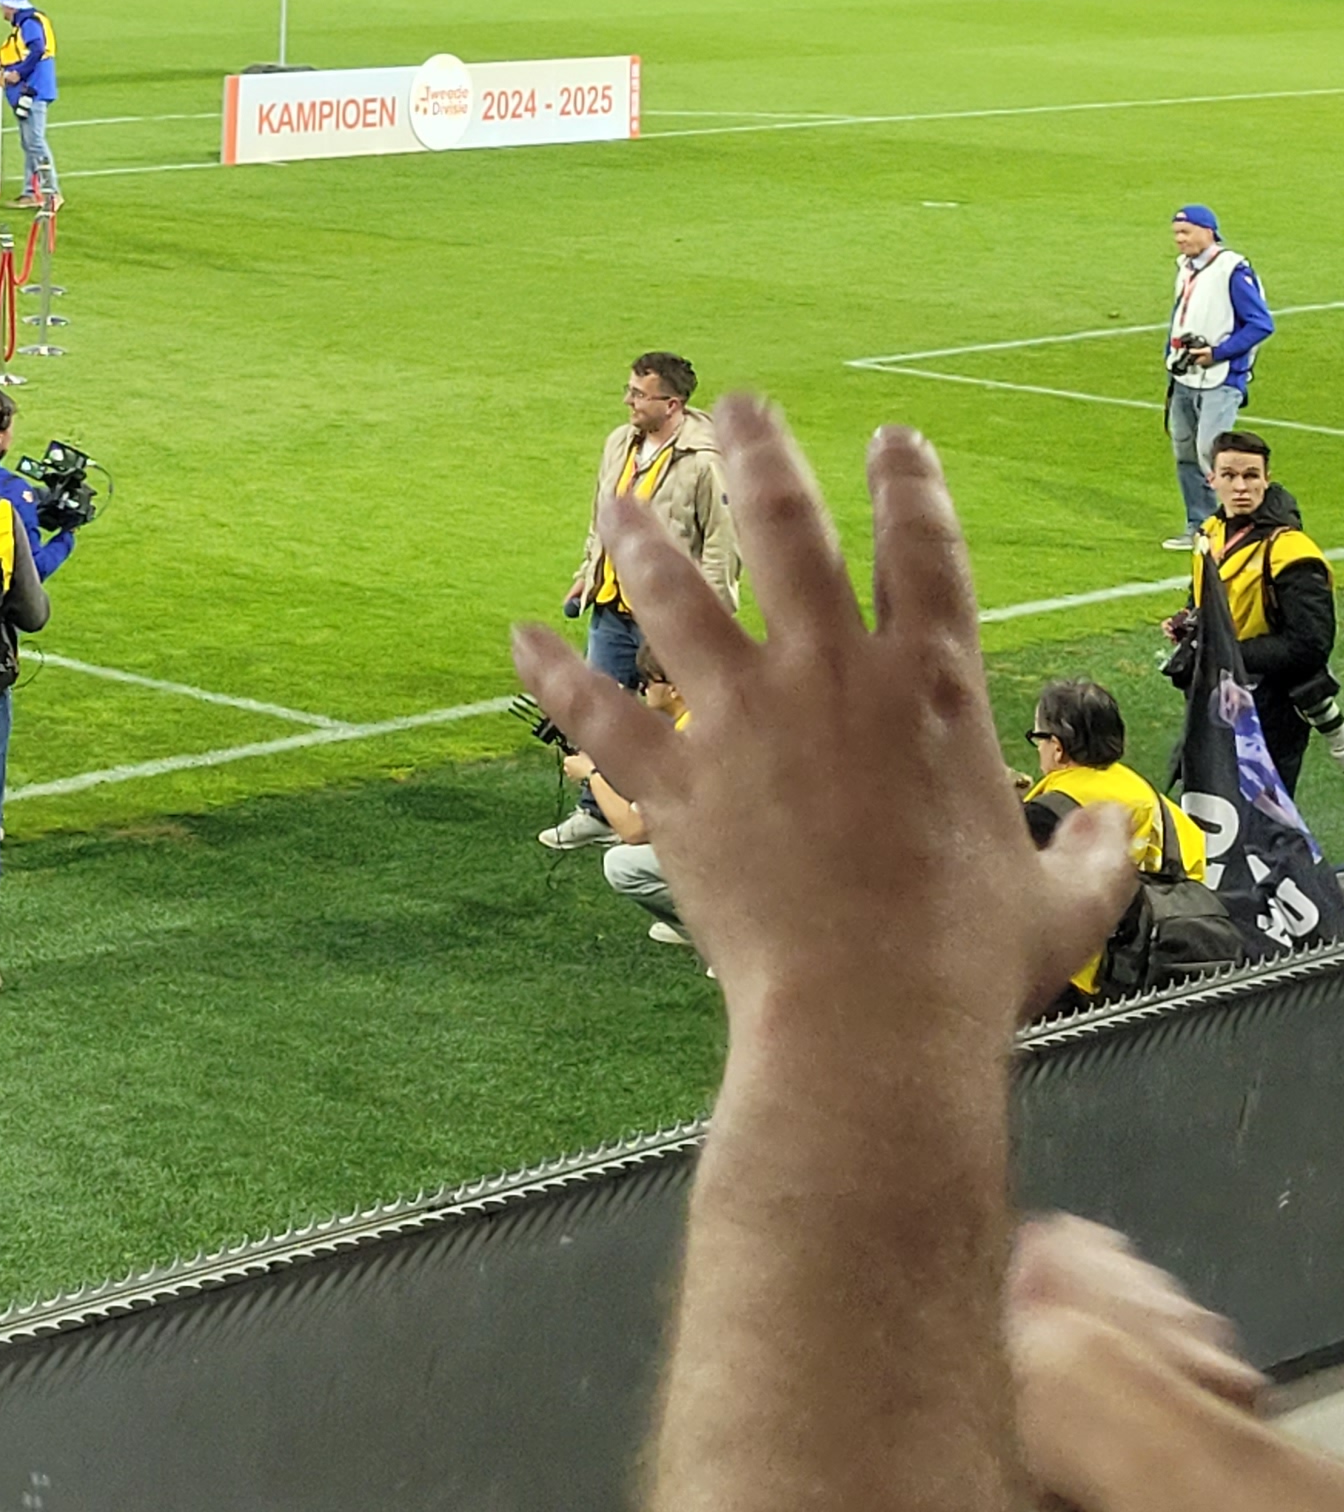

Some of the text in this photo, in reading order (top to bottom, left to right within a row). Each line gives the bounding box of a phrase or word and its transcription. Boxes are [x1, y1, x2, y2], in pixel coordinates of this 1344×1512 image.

[258, 95, 396, 136] KAMPIOEN
[481, 89, 537, 121] 2024
[559, 84, 613, 116] 2025
